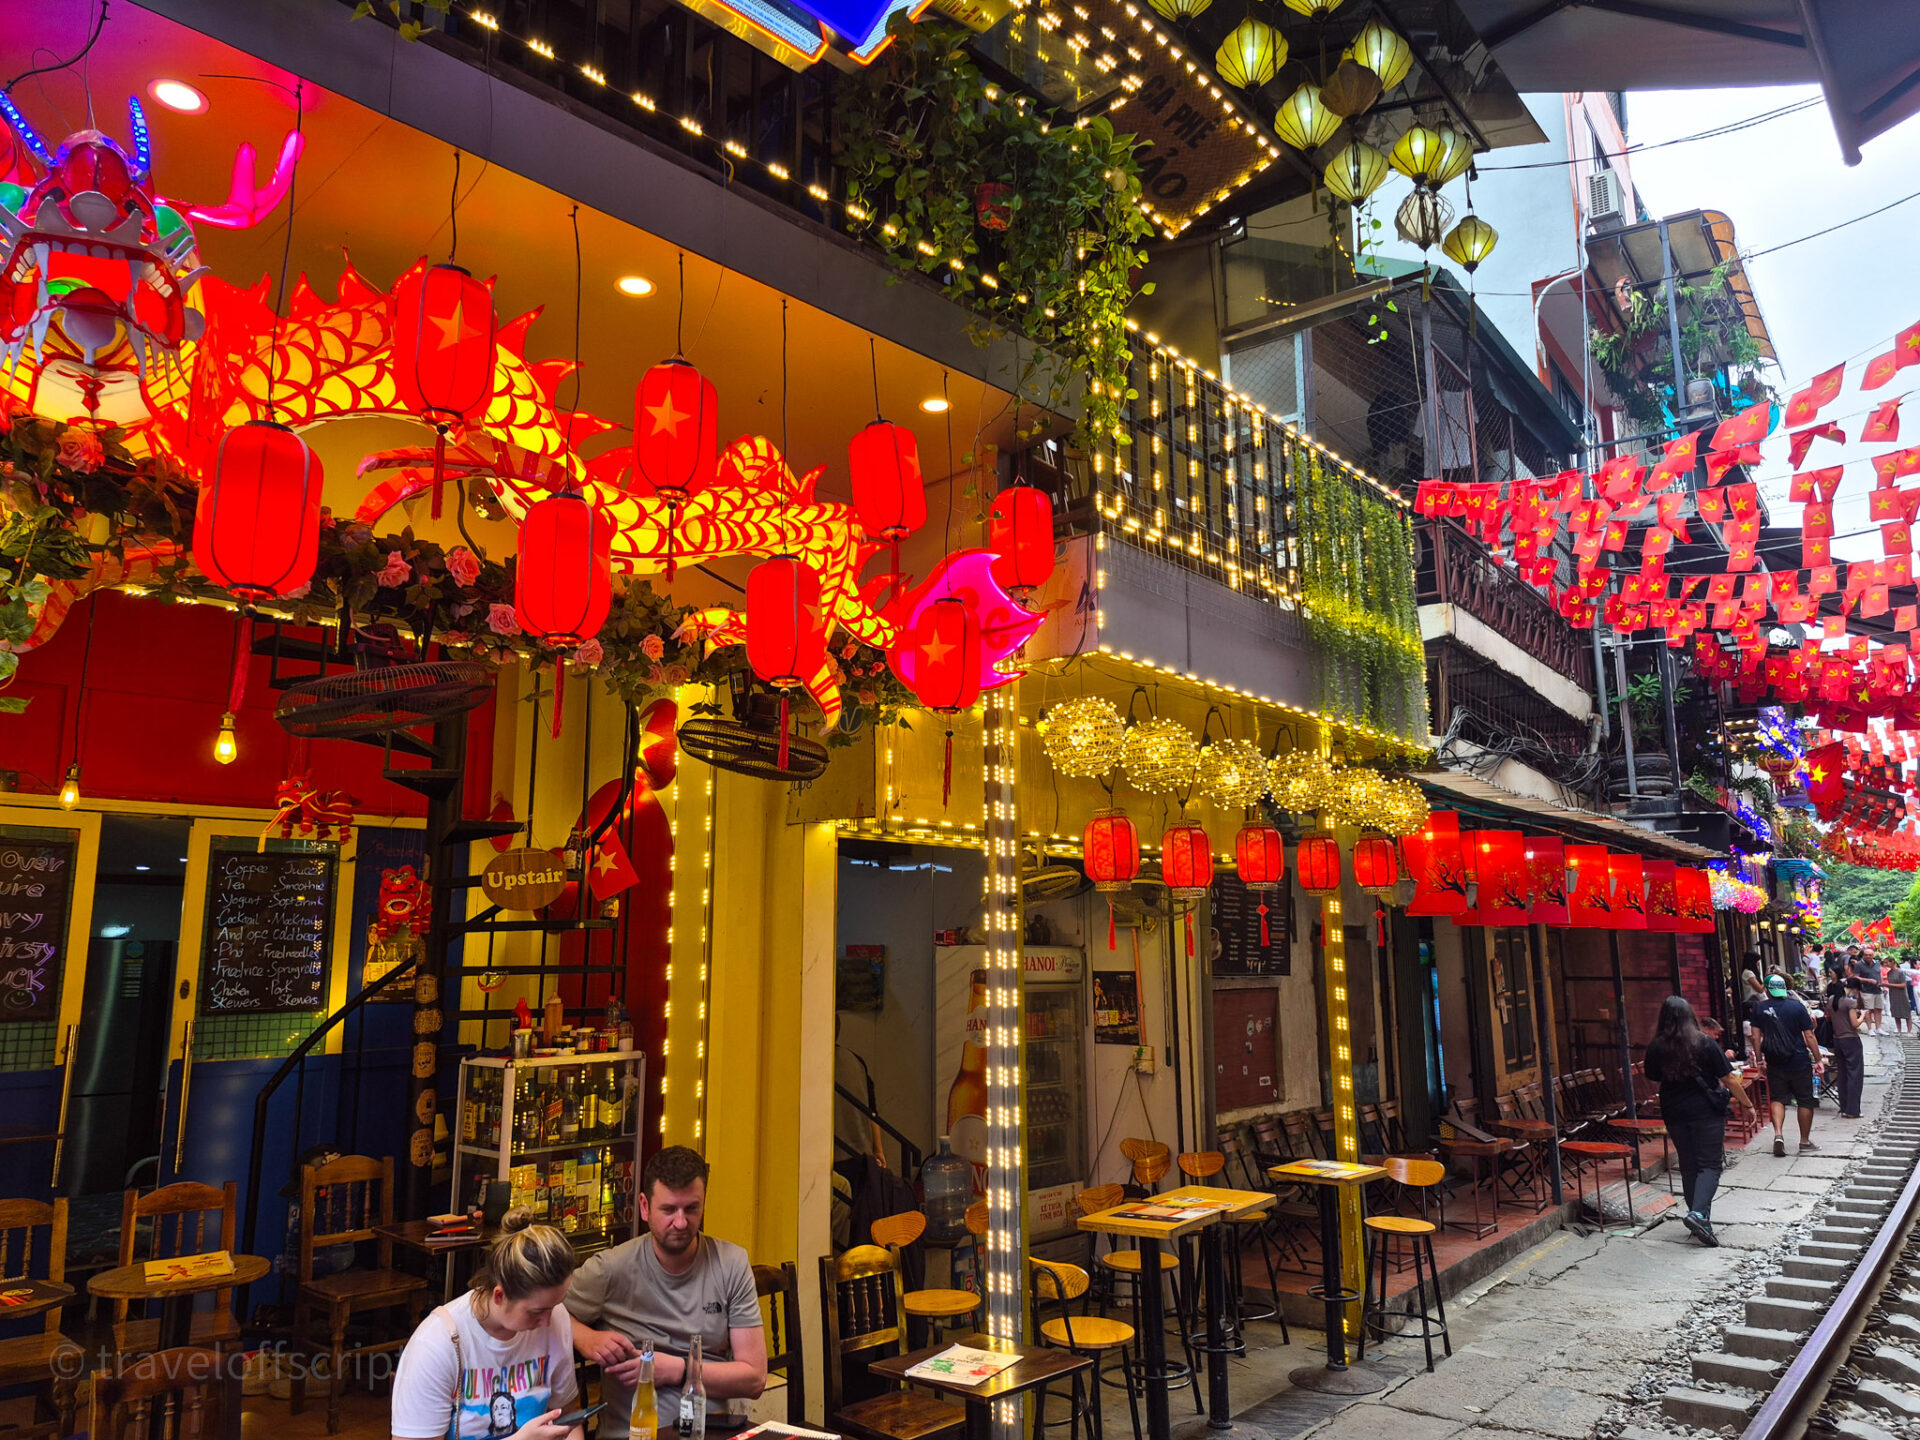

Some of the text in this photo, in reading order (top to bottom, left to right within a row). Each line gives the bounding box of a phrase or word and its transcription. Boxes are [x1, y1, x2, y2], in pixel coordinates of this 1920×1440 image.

[225, 857, 269, 881] Coffee
[224, 875, 325, 892] Tea Smoothie
[487, 867, 563, 890] Upstair
[221, 892, 262, 909] Yogurt
[216, 925, 244, 941] And
[270, 979, 293, 996] Pork
